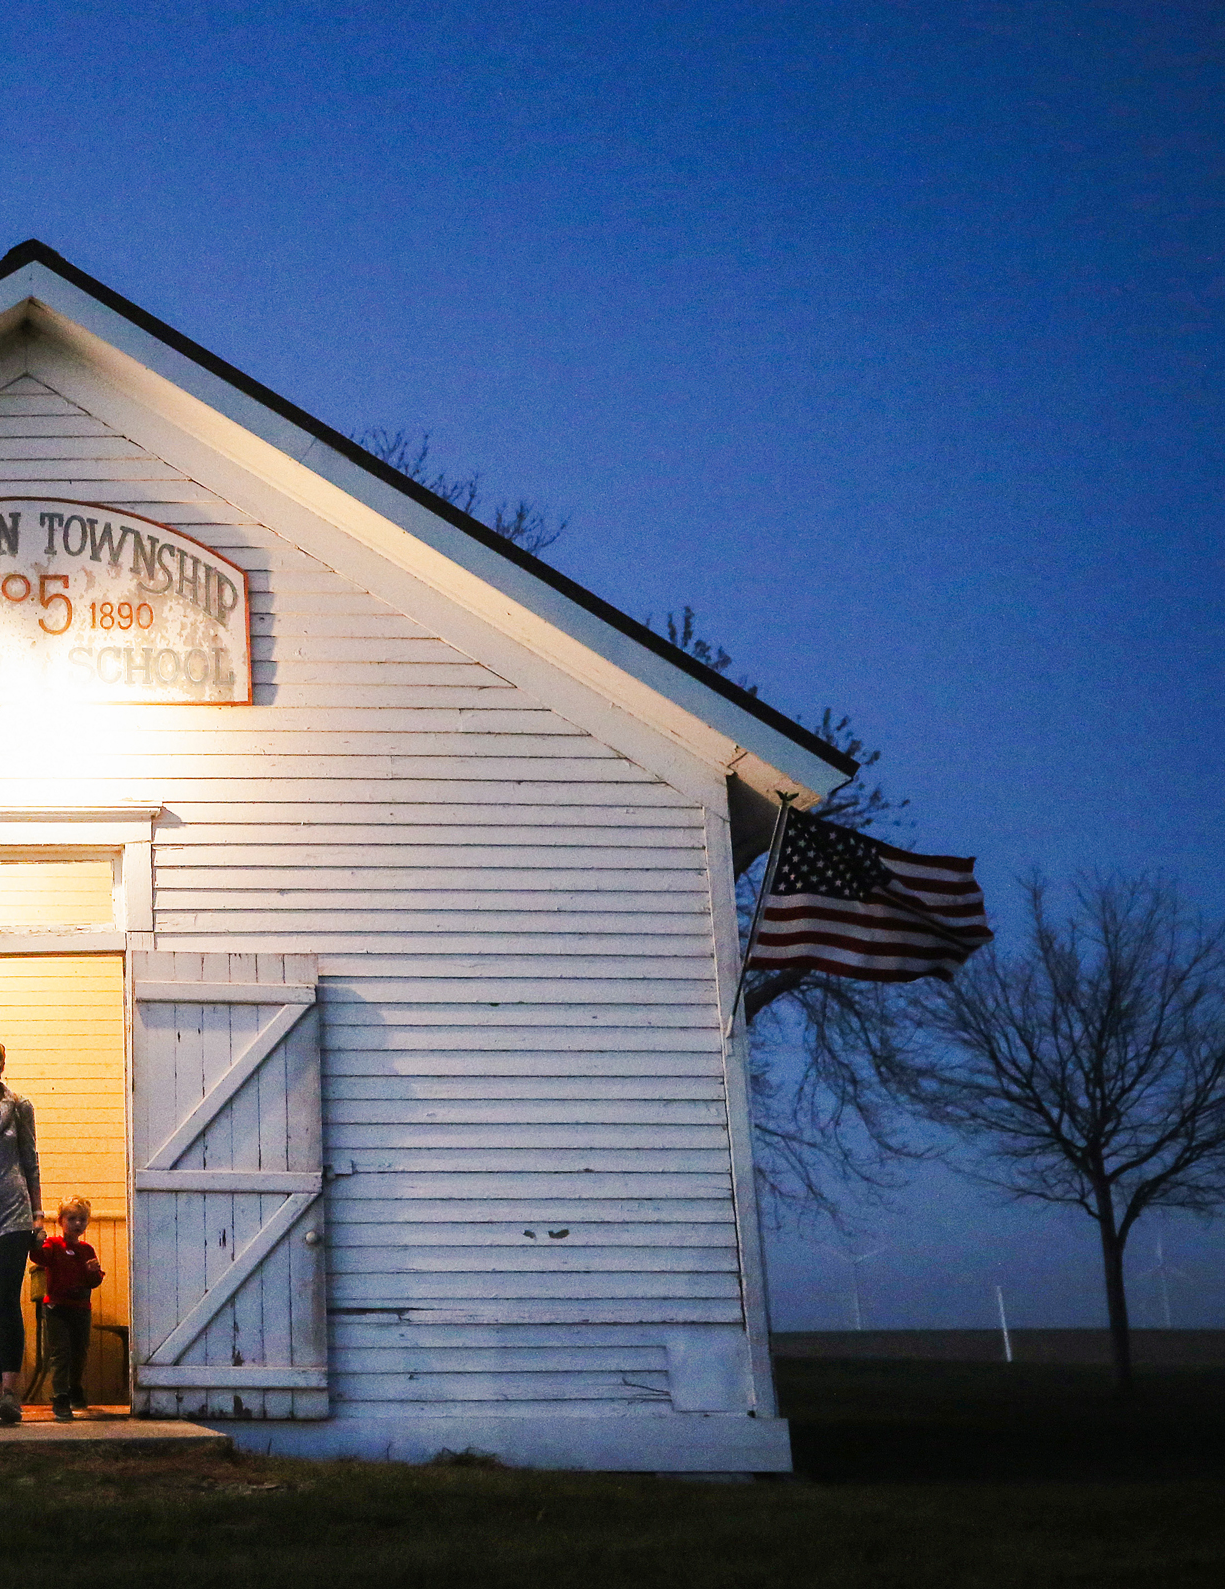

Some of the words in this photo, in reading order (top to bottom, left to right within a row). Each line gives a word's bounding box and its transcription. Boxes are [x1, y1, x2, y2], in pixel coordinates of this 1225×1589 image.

[40, 512, 239, 629] TOWNSHIP
[38, 574, 74, 635] 5
[89, 602, 155, 631] 1890
[67, 646, 234, 687] SCHOOL
